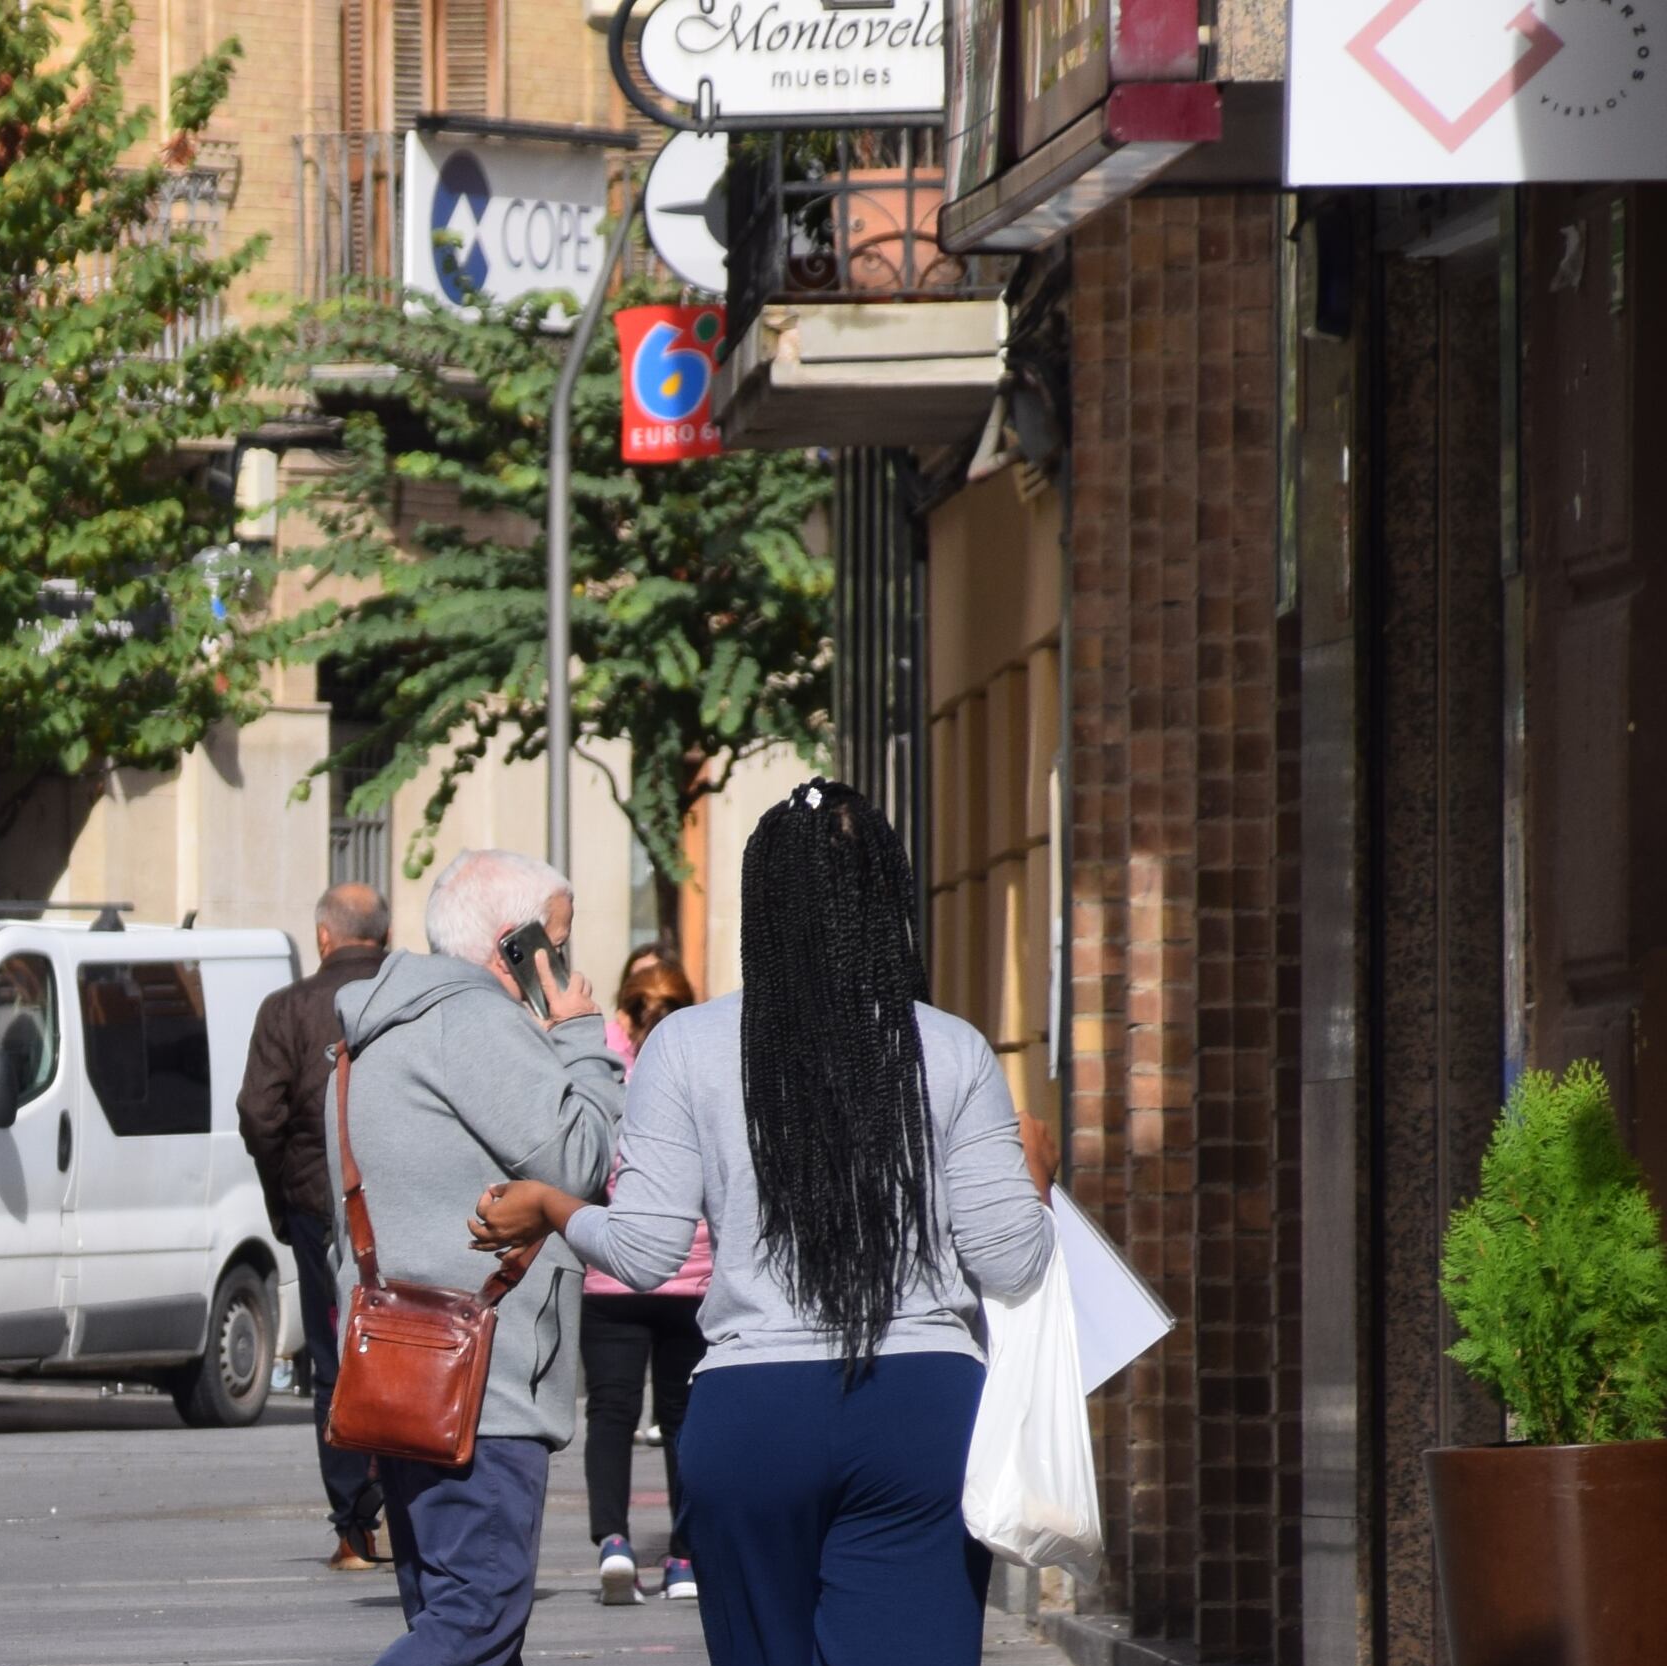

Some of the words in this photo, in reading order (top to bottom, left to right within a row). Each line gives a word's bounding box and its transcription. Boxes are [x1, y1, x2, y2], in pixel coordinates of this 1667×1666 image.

[772, 66, 891, 88] muebles
[502, 198, 591, 272] COPE
[630, 423, 695, 450] EURO
[701, 421, 722, 441] 6
